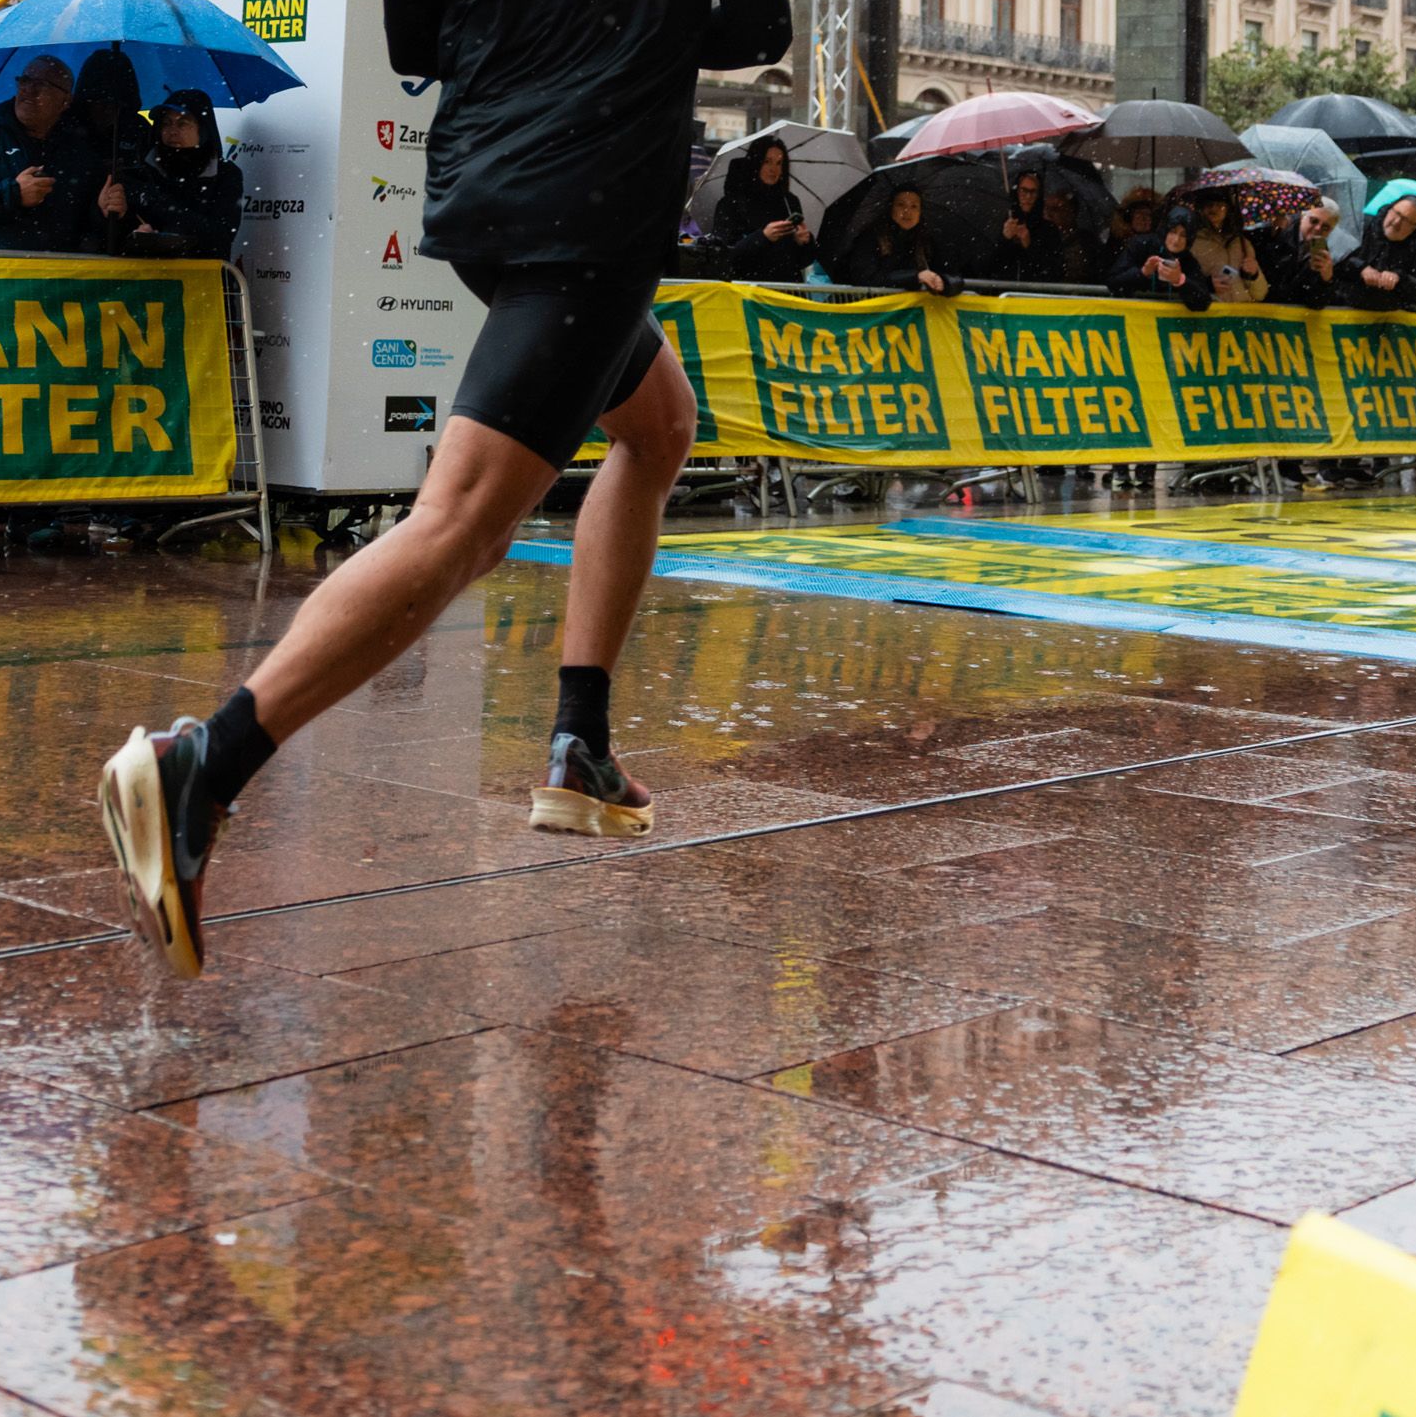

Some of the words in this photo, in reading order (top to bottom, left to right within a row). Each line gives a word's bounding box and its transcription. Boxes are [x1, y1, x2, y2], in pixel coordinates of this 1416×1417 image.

[244, 195, 305, 220] Zaragoza
[256, 267, 291, 280] turismo
[400, 299, 453, 312] HYUNDAI
[374, 354, 415, 366] CENTRO
[375, 342, 399, 353] SANI
[757, 319, 925, 375] MANN
[969, 326, 1126, 377] MANN
[1169, 330, 1310, 379] MANN
[769, 381, 940, 436] FILTER
[981, 386, 1141, 436] FILTER
[1181, 387, 1322, 432] FILTER
